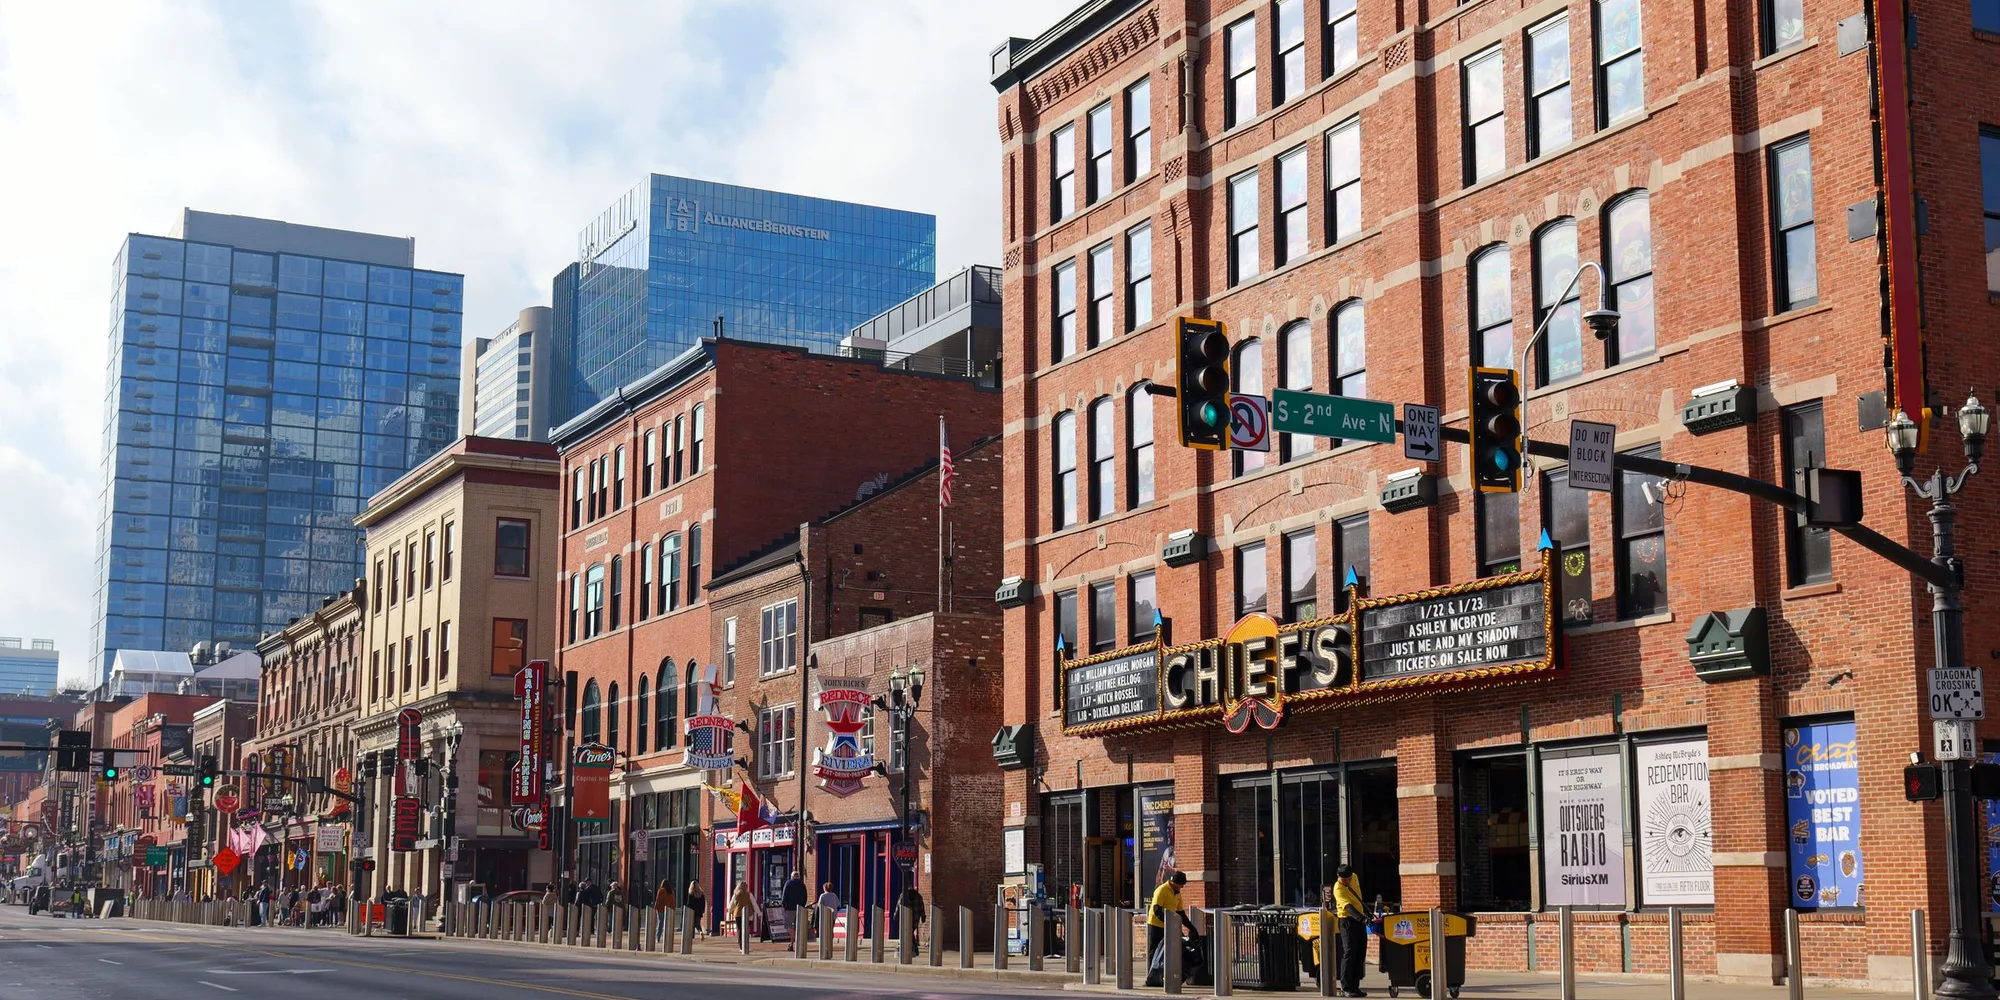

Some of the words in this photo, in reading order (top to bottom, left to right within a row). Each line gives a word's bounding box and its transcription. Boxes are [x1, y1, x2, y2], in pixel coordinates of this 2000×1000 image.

[676, 199, 690, 213] A
[676, 216, 688, 232] B
[1408, 410, 1436, 425] ONE
[1407, 423, 1437, 439] WAY
[1576, 428, 1588, 443] DO
[1593, 430, 1610, 445] NOT
[1577, 446, 1606, 463] BLOCK
[1571, 469, 1612, 485] INTERSECTION
[1421, 603, 1444, 619] 1/22
[1448, 601, 1455, 614] &
[1459, 597, 1484, 613] 1/23
[1409, 621, 1446, 637] ASHLEY
[1450, 612, 1497, 630] MCBRYDE
[1389, 642, 1414, 657] JUST
[1418, 639, 1431, 652] ME
[1435, 636, 1455, 650] AND
[1458, 632, 1473, 647] MY
[1477, 625, 1519, 643] SHADOW
[1396, 654, 1436, 672] TICKETS
[1440, 652, 1454, 666] ON
[1457, 647, 1483, 664] SALE
[1486, 644, 1508, 660] NOW
[1086, 665, 1107, 680] WILLIAM
[1108, 661, 1130, 676] MICHAEL
[1131, 656, 1154, 671] MORGAN
[1163, 625, 1339, 708] CHIEF'S
[1117, 673, 1141, 687] KELLOGG
[1935, 670, 1976, 680] DIAGONAL
[823, 679, 842, 687] JOHN
[843, 680, 866, 688] RICH'S
[1936, 680, 1977, 690] CROSSING
[820, 690, 871, 706] REDNECK
[1097, 690, 1112, 704] MITCH
[1113, 687, 1138, 701] ROSSELL
[1932, 694, 1953, 713] OK
[523, 668, 533, 740] RAISING
[1093, 703, 1120, 719] DIXIELAND
[1121, 700, 1143, 714] DELIGHT
[689, 716, 735, 731] REDNECK
[578, 749, 613, 764] Cane's
[689, 756, 733, 769] RIVIERA
[821, 755, 871, 770] RIVIERA
[1654, 751, 1672, 761] Ashley
[1647, 762, 1710, 786] REDEMPTION
[1814, 761, 1858, 772] BROADWAY
[576, 775, 598, 783] Capitol
[1573, 782, 1602, 790] HIGHWAY
[1670, 784, 1689, 804] BAR
[1804, 787, 1858, 804] VOTED
[1560, 803, 1605, 832] OUTSIDERS
[1812, 806, 1852, 823] BEST
[735, 833, 750, 843] HOME
[754, 832, 761, 842] OF
[762, 831, 771, 841] THE
[775, 829, 794, 840] HEROES
[1816, 826, 1850, 842] BAR
[1561, 832, 1606, 867] RADIO
[1561, 873, 1609, 885] SiriusXM
